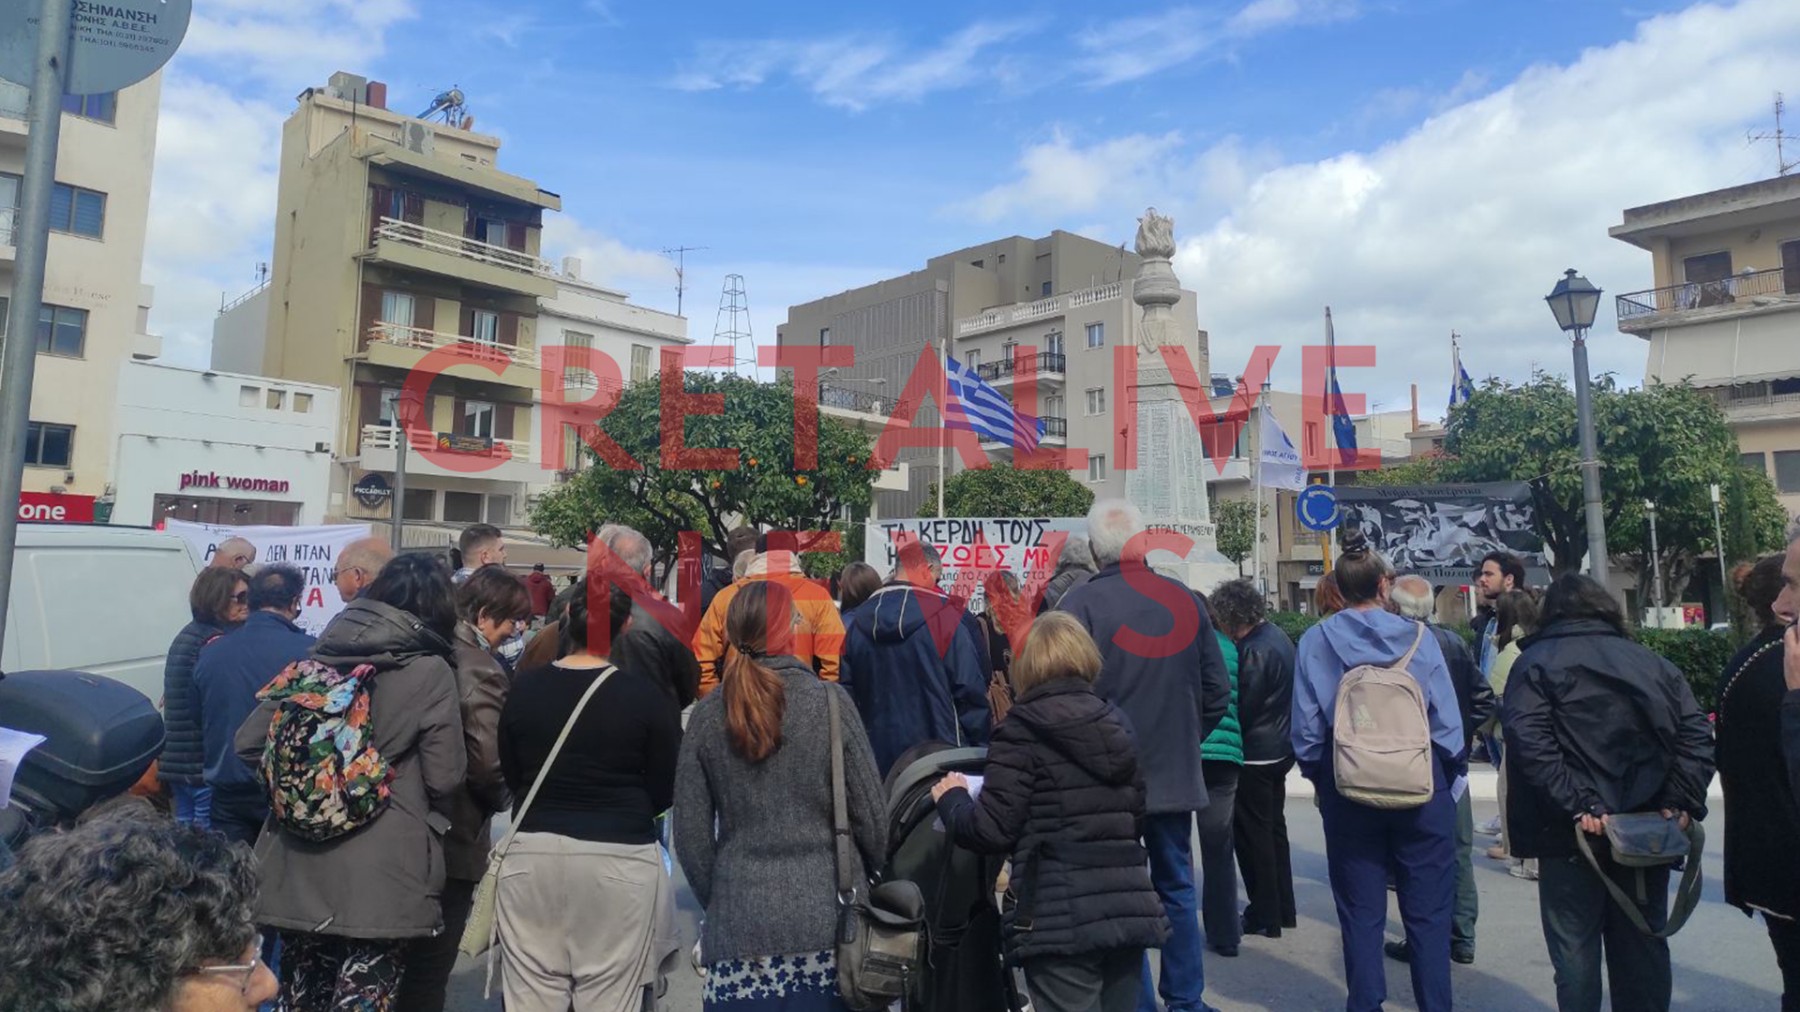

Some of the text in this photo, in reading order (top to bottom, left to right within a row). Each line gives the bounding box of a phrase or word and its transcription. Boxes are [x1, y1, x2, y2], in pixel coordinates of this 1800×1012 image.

[179, 470, 290, 493] pink woman
[18, 503, 66, 520] one
[881, 519, 1051, 547] ΤΑ ΚΕΡΔΗ ΤΟΥΣ
[265, 544, 331, 562] ΔΕΝ ΗΤΑΝ
[1023, 548, 1050, 569] ΜΑ
[300, 566, 333, 586] ΤΑΝ
